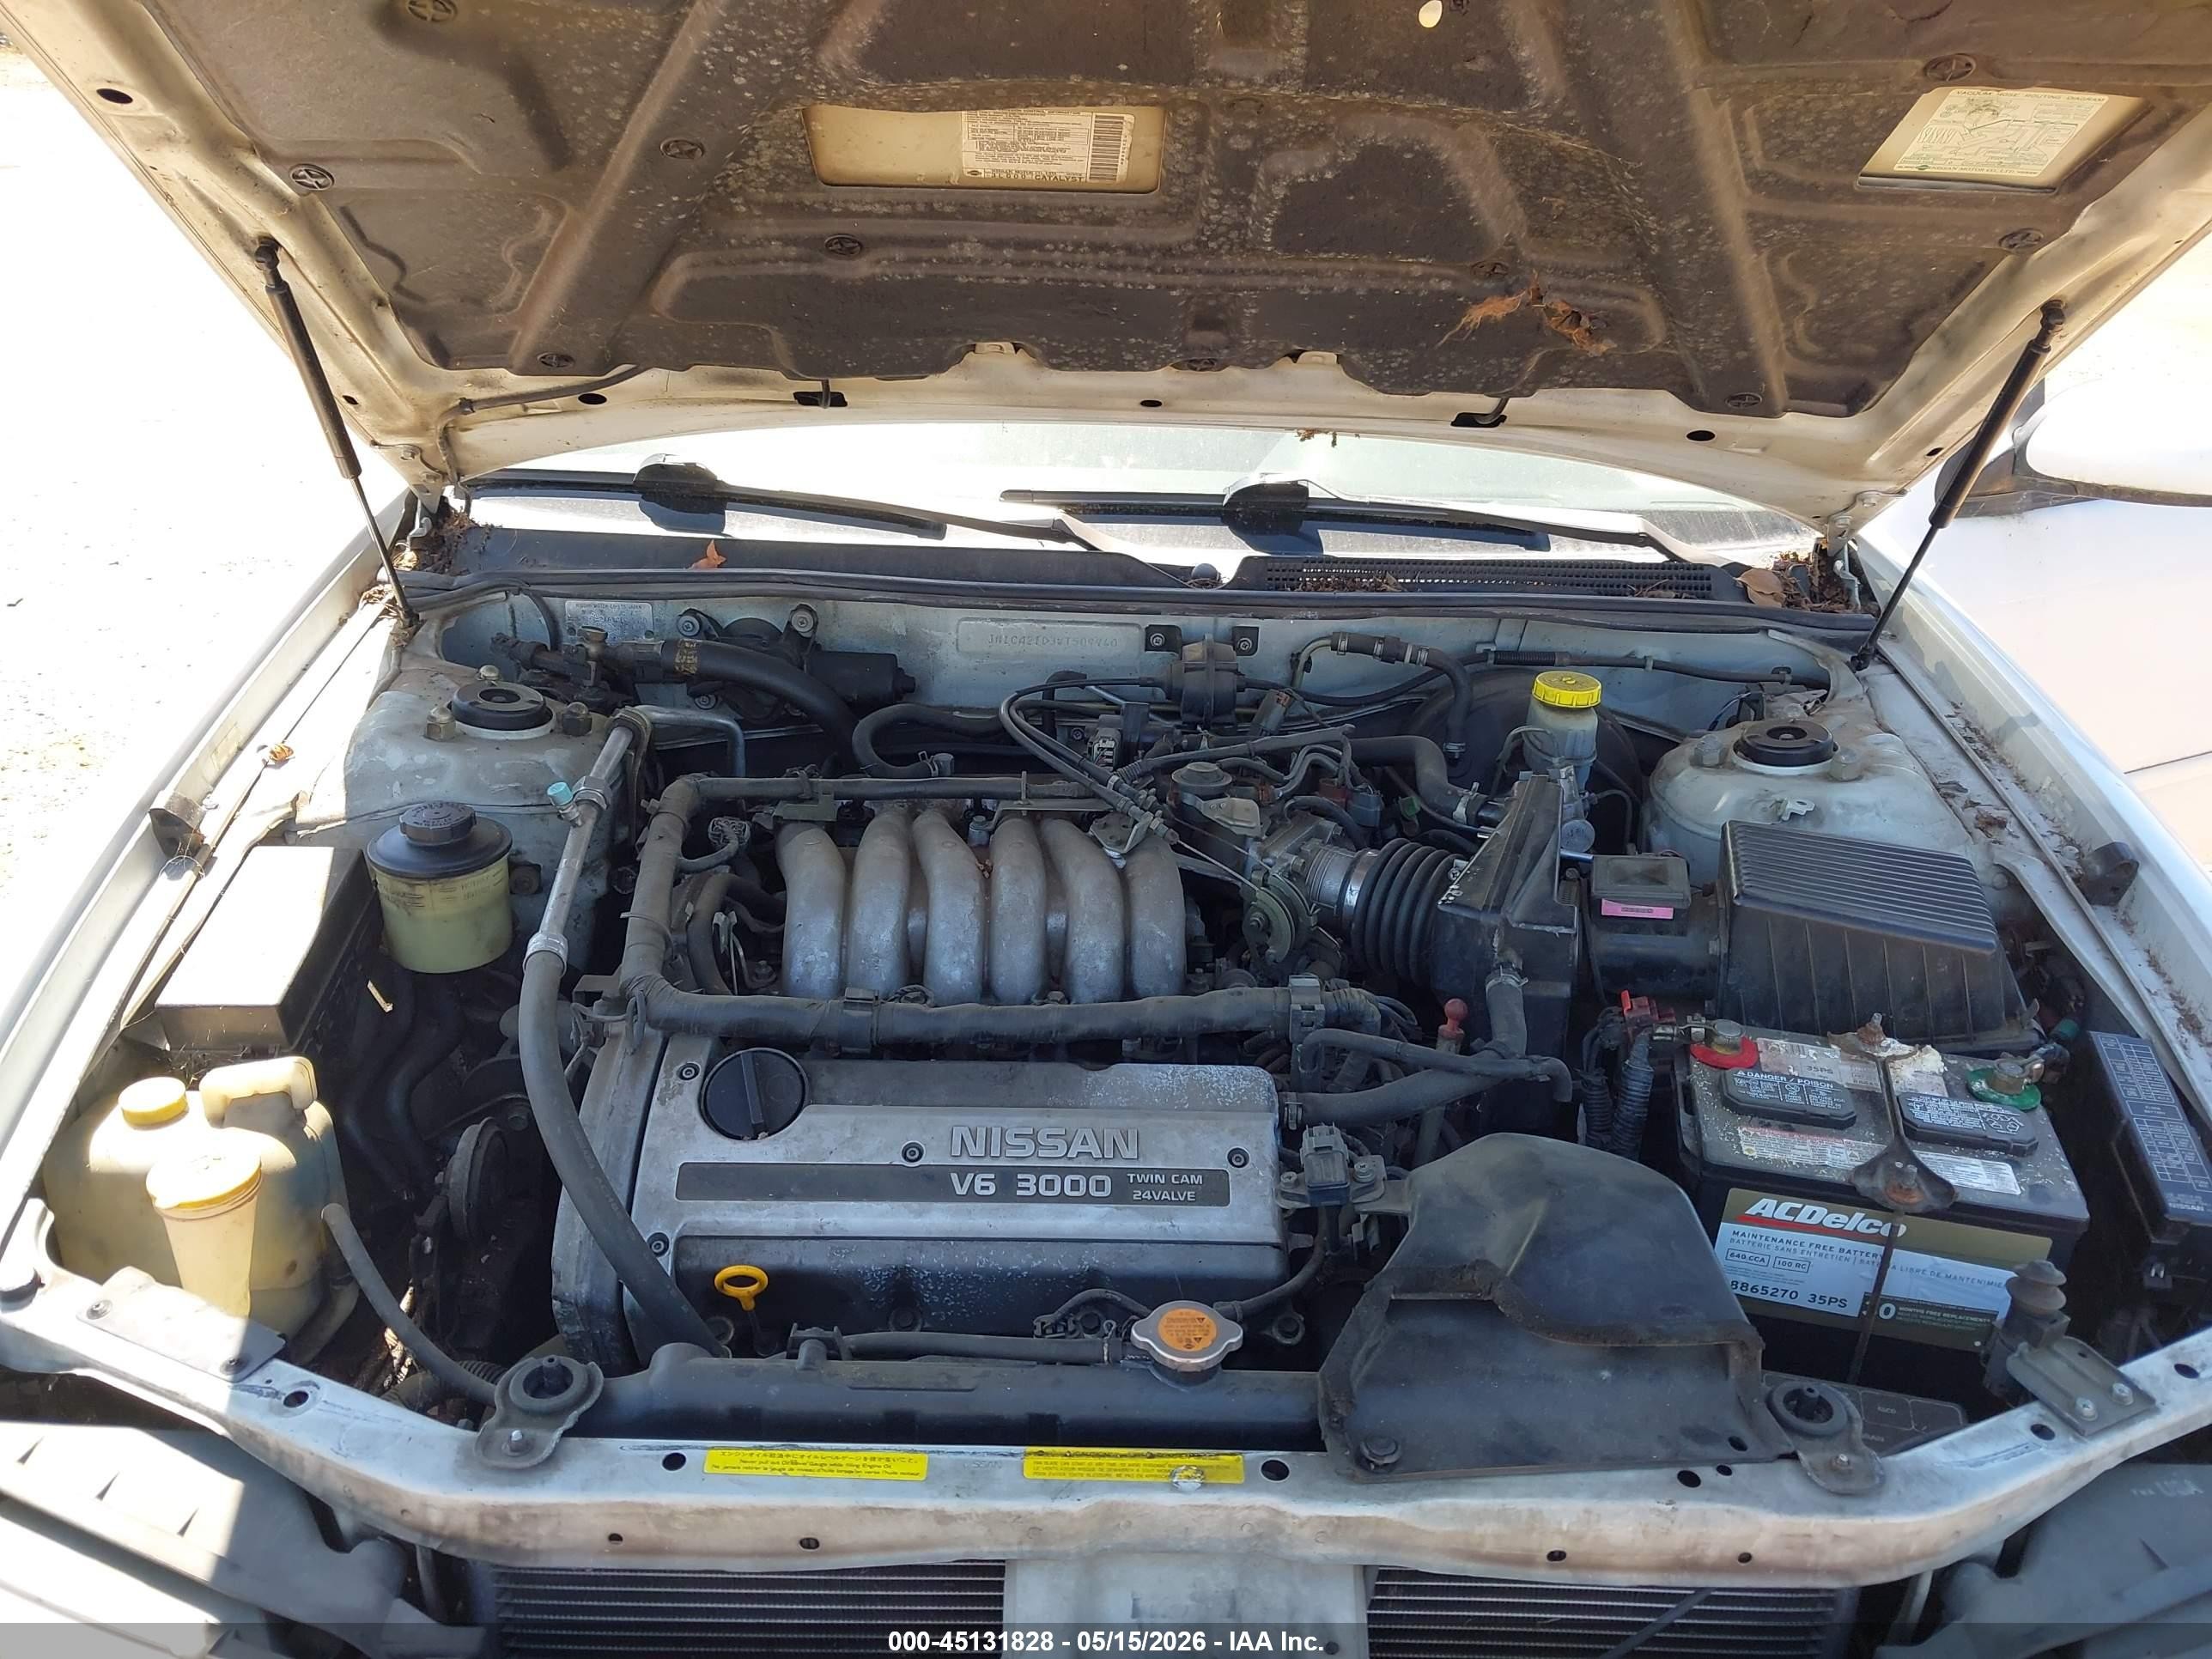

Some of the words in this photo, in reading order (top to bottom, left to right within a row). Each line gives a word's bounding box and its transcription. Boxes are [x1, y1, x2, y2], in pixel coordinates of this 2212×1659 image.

[1035, 174, 1084, 183] CATALYST
[1806, 1065, 1834, 1074] 35PS
[1747, 1072, 1787, 1082] DANGER
[1797, 1078, 1834, 1089] POISON
[951, 1125, 1139, 1160] NISSAN
[950, 1172, 996, 1196] V6
[1016, 1174, 1112, 1197] 3000
[1127, 1173, 1165, 1185] TWIN
[1170, 1174, 1203, 1185] CAM
[1133, 1189, 1196, 1202] 24VALVE
[1745, 1198, 1907, 1237] ACDelco
[1732, 1230, 1806, 1248] MAINTENANCE
[1808, 1243, 1835, 1252] FREE
[1729, 1237, 1771, 1250] BATTERIE
[1774, 1245, 1798, 1255] SANS
[1801, 1249, 1850, 1263] ENTRETIEN
[1899, 1266, 1927, 1276] LIBRE
[1929, 1270, 1941, 1279] DE
[1944, 1273, 2007, 1288] MANTENIMIE
[1748, 1255, 1765, 1263] CCA
[1731, 1280, 1799, 1300] 8865270
[1808, 1293, 1848, 1309] 35PS
